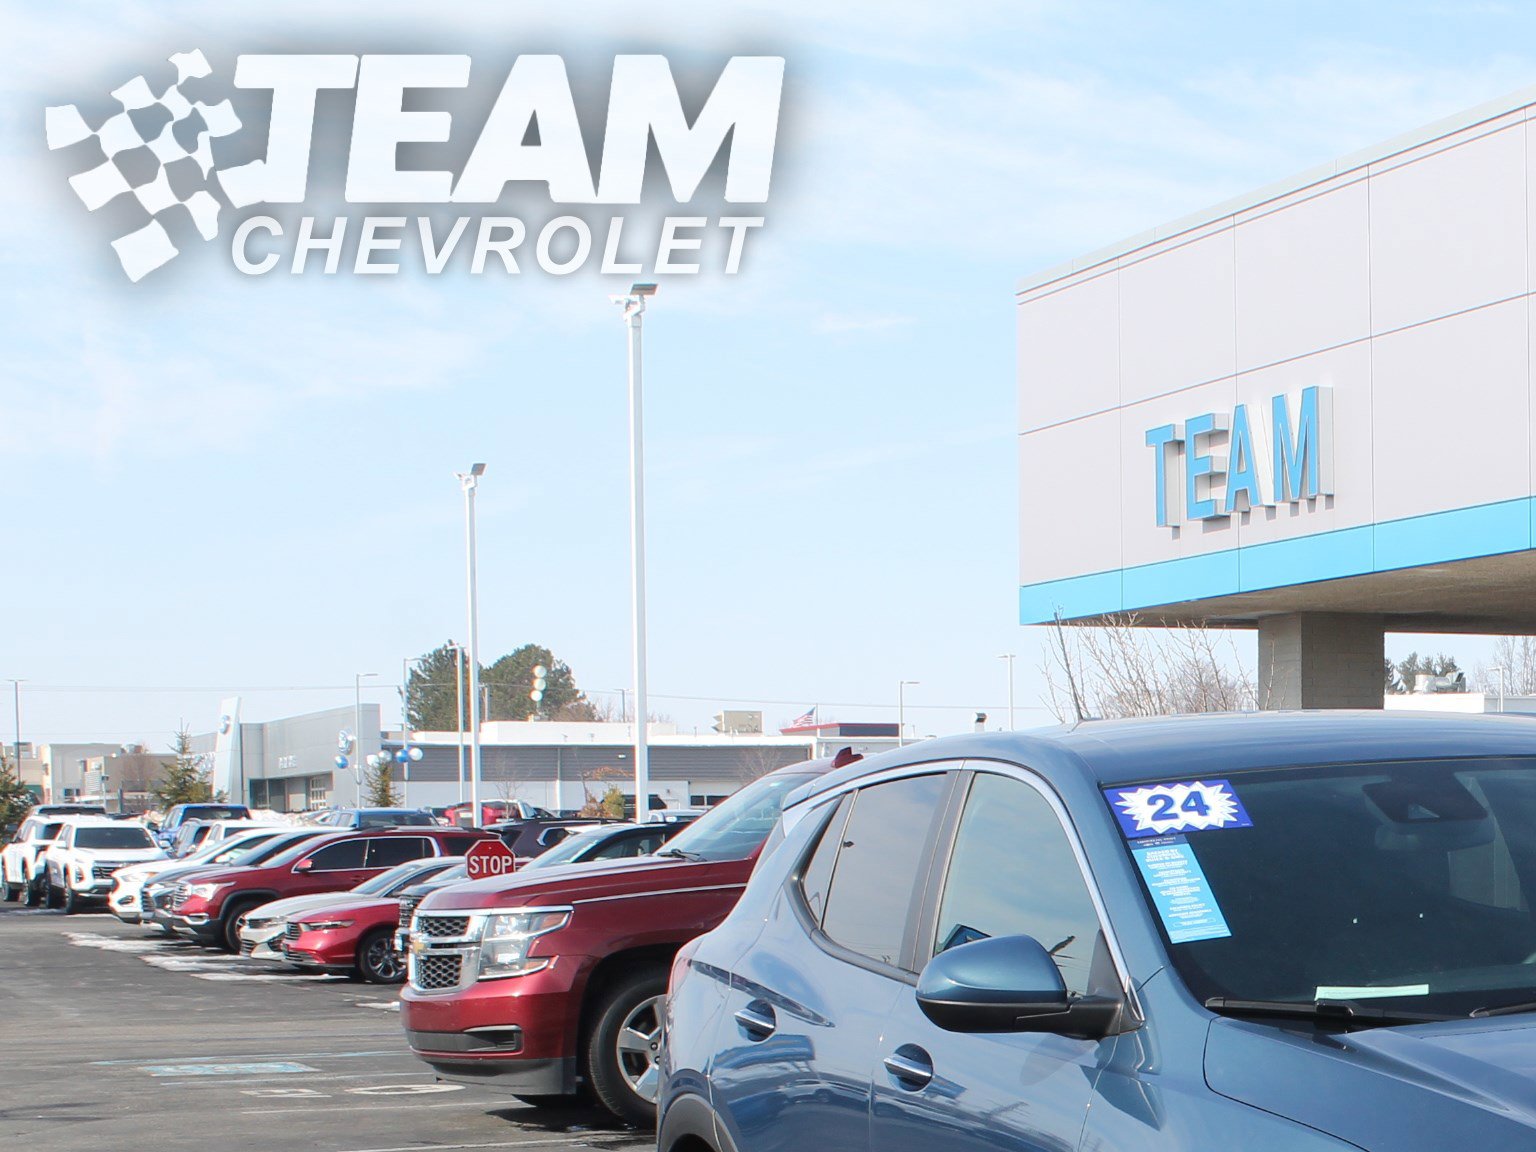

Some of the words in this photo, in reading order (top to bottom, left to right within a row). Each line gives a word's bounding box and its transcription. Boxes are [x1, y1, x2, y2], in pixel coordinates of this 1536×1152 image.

[1145, 385, 1332, 528] TEAM
[1147, 790, 1210, 822] 24
[469, 856, 513, 874] STOP
